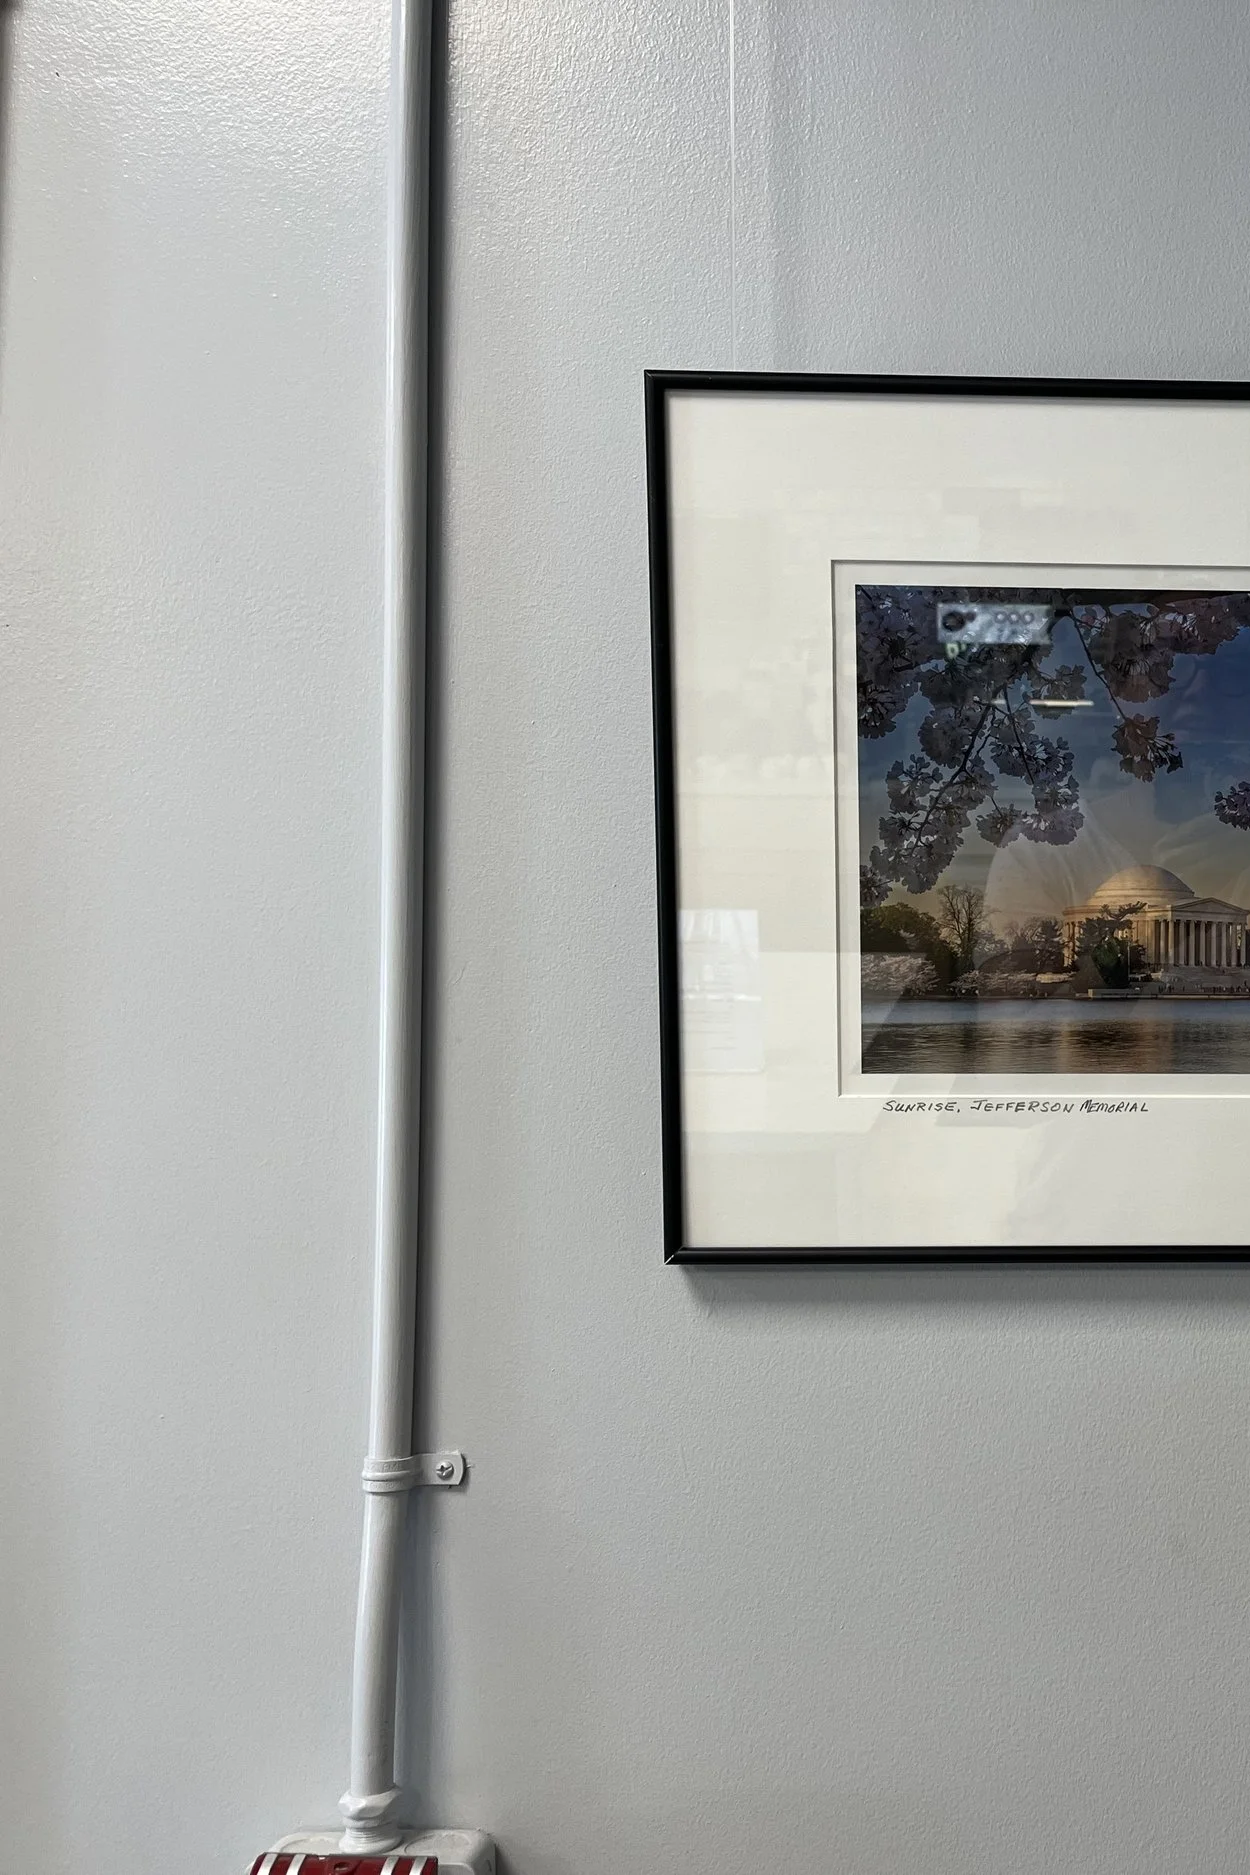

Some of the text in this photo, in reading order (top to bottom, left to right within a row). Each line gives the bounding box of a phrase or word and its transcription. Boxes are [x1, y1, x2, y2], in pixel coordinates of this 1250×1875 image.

[883, 1099, 1149, 1114] SUNRISE, JEFFERSON MEMORIAL
